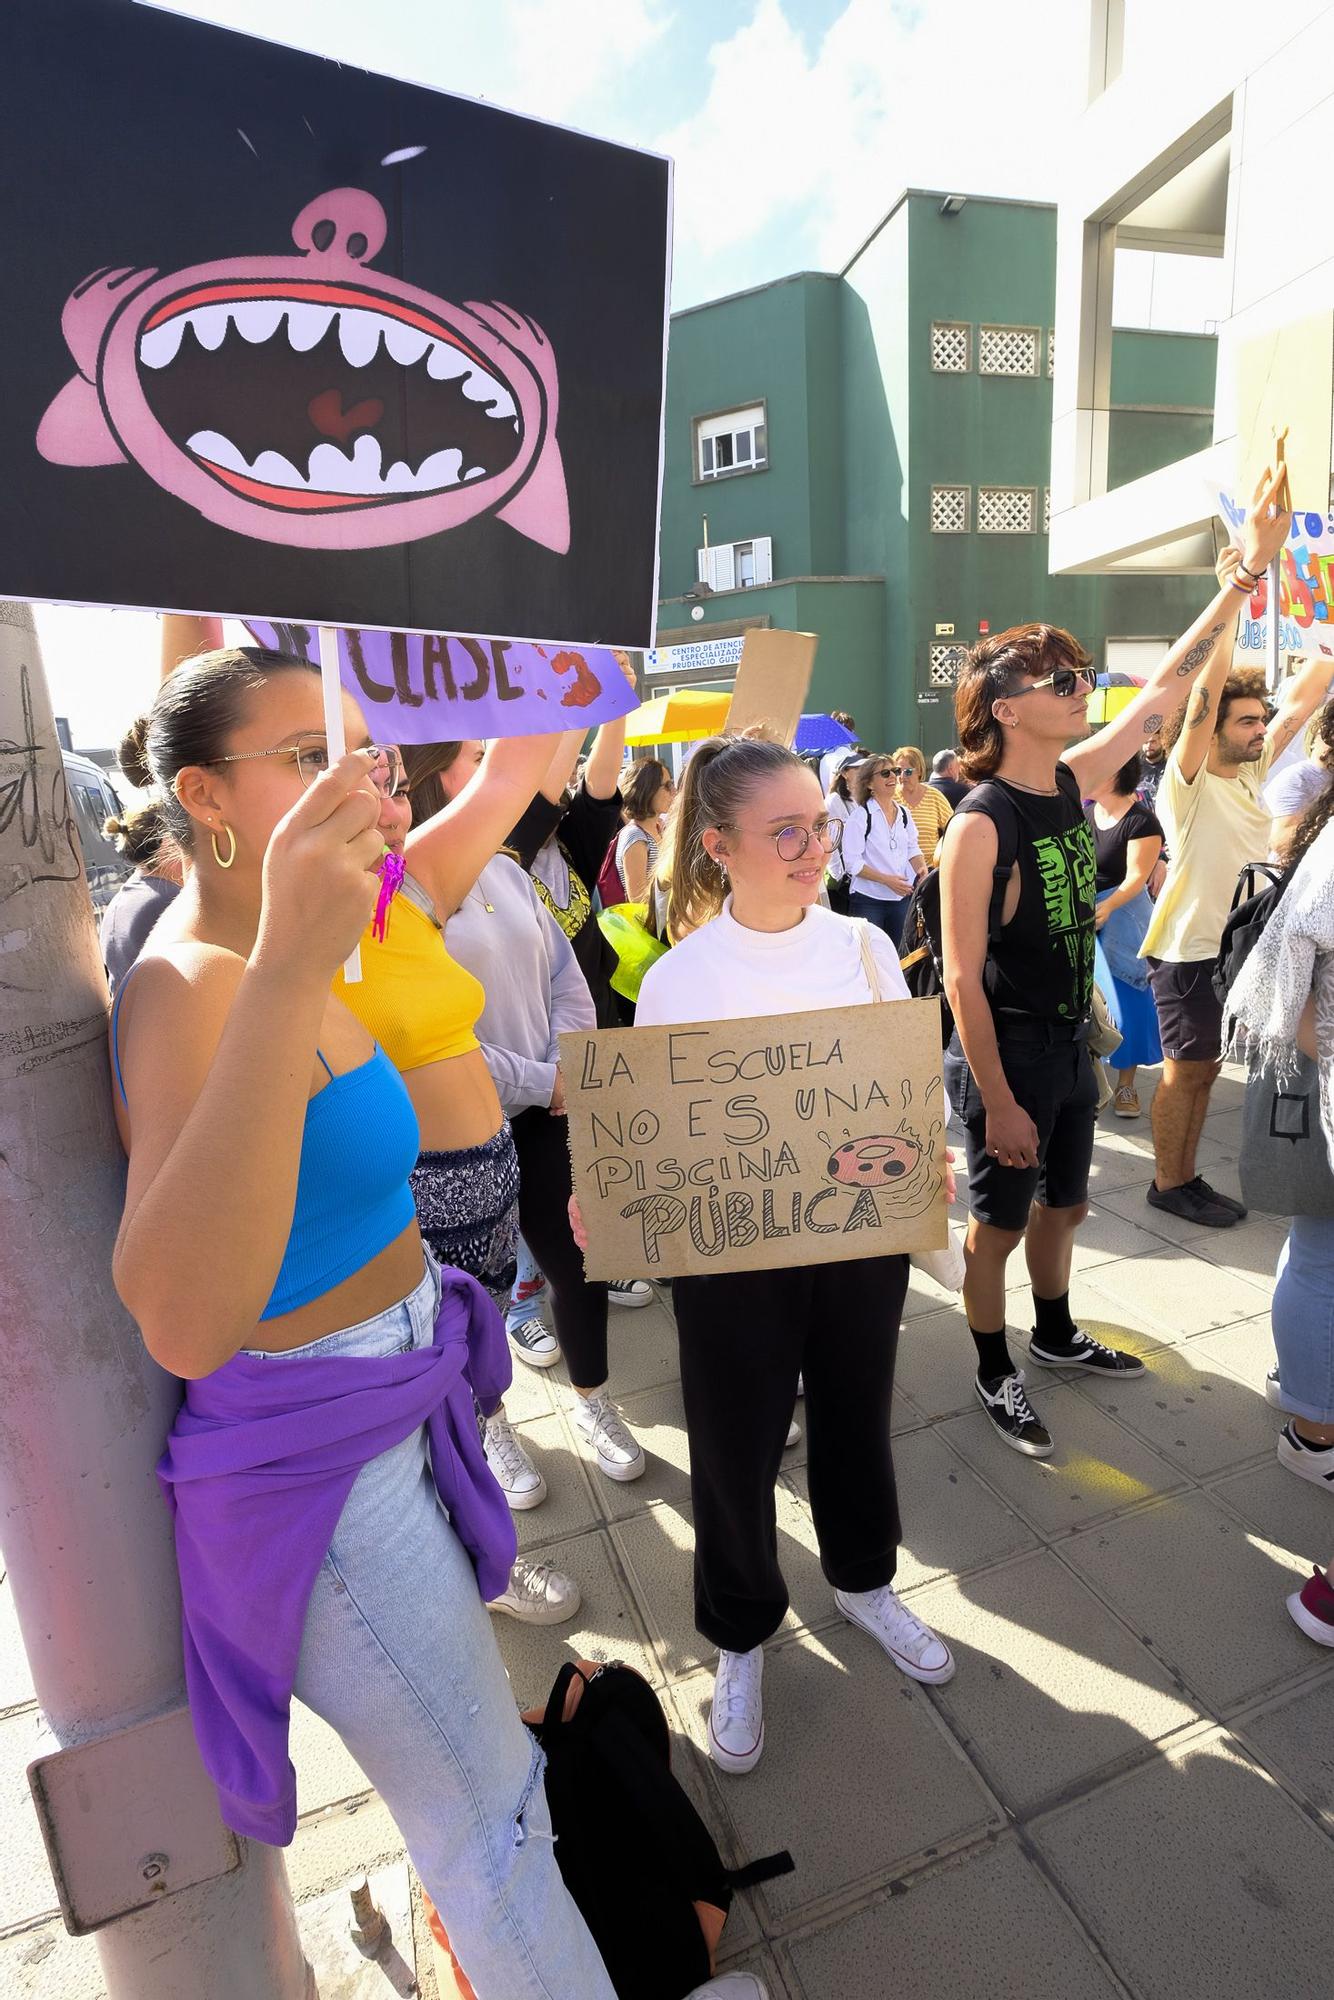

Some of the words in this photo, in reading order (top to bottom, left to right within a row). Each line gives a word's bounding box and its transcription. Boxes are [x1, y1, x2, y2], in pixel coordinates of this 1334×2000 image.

[672, 645, 701, 656] CENTRO
[703, 643, 712, 652] DE
[672, 658, 716, 669] PRUDENCIO
[680, 647, 743, 661] ESPECIALIZADA
[580, 1040, 634, 1090] LA
[668, 1032, 843, 1085] ESCUELA
[591, 1109, 660, 1148] NO
[688, 1094, 770, 1146] ES
[795, 1080, 890, 1121] UNA
[586, 1141, 800, 1199] PISCINA
[620, 1185, 882, 1264] PÚBLICA
